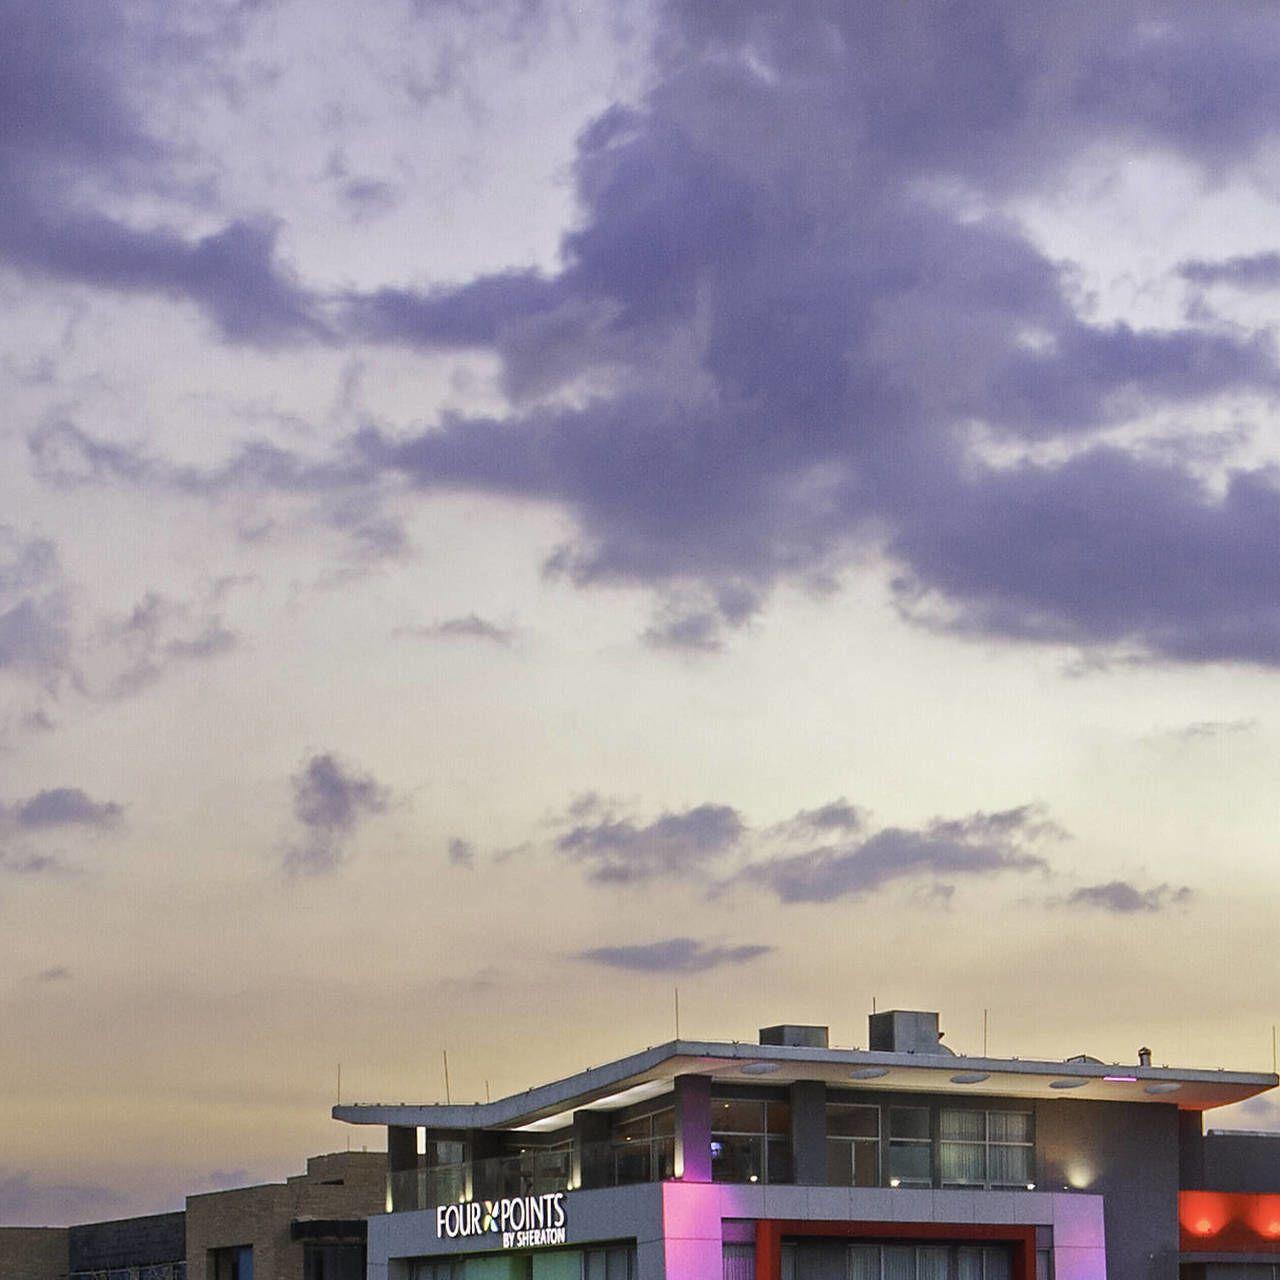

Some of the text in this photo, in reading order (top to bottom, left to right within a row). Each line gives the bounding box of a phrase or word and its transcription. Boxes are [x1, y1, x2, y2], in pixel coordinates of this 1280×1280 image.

[437, 1193, 565, 1238] FOUR POINTS
[503, 1227, 566, 1248] BY SHERATON
